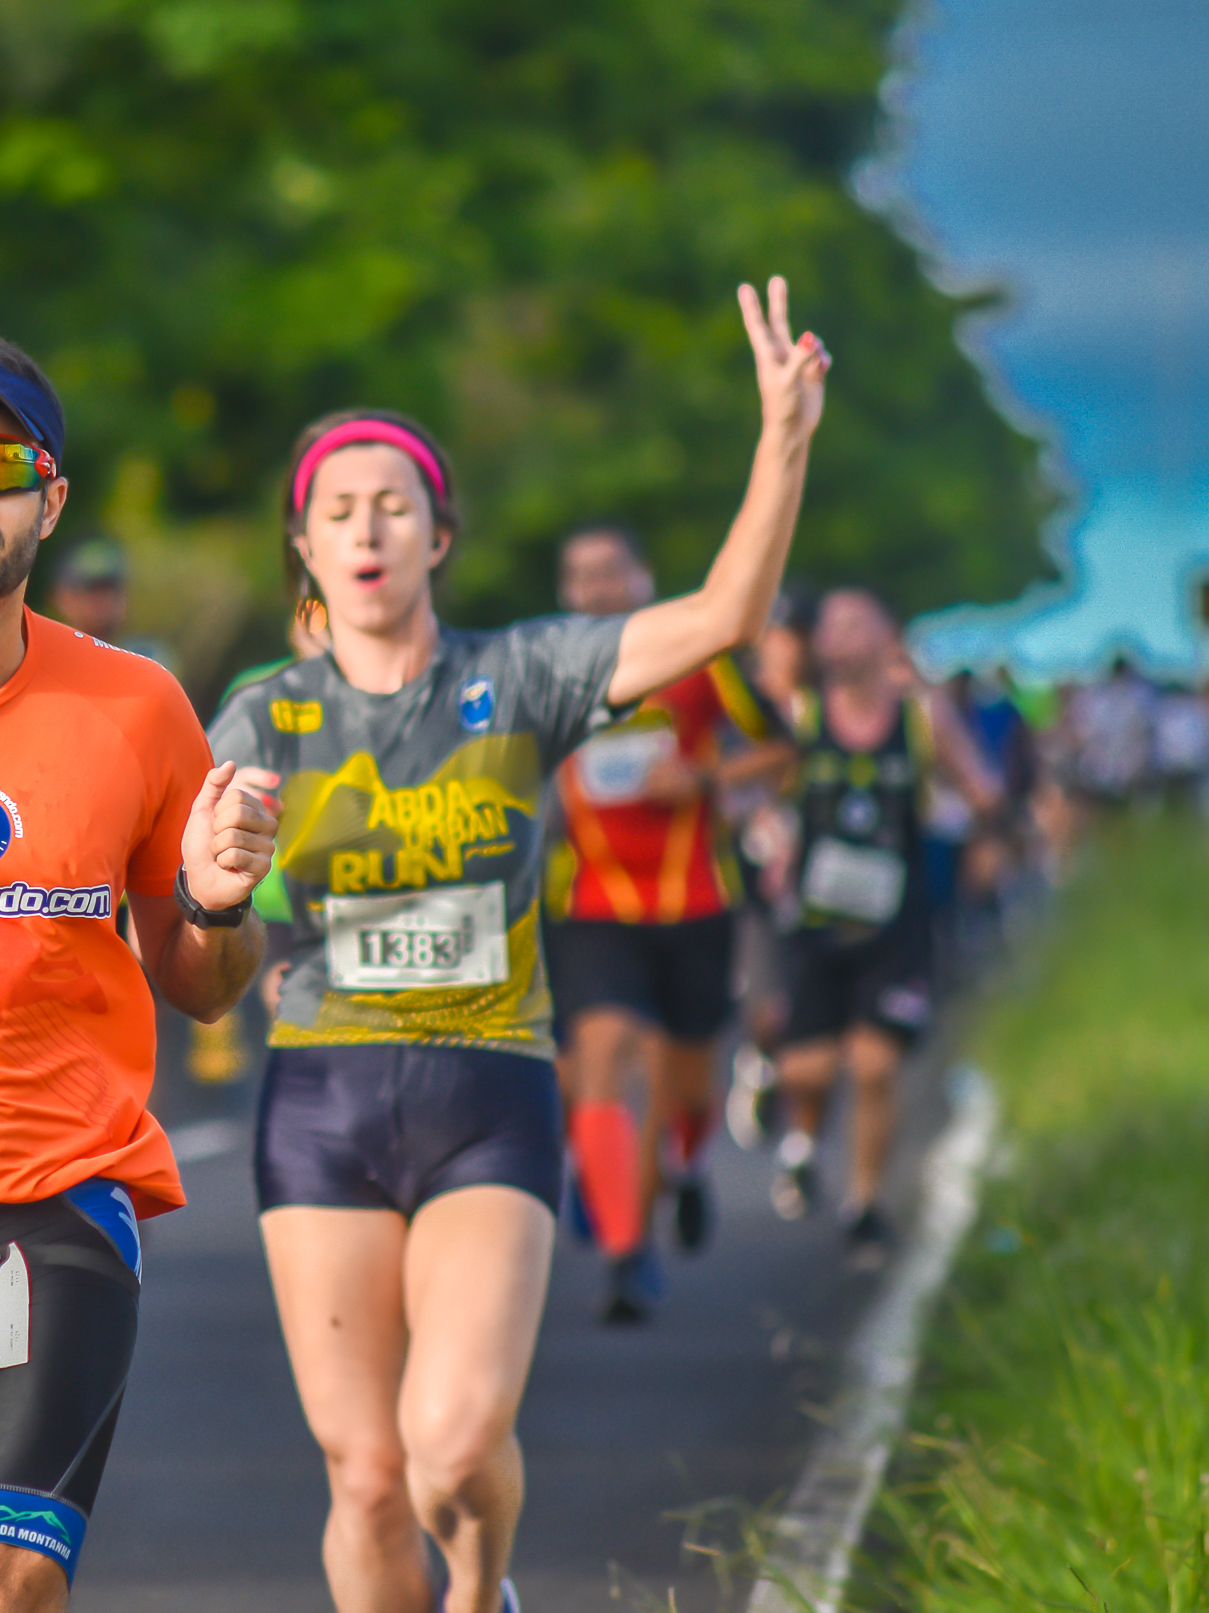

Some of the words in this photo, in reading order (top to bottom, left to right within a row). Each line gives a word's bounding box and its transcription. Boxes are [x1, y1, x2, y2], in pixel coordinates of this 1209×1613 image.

[368, 779, 476, 830] ABDA
[328, 845, 464, 894] RUN
[365, 932, 458, 967] 1383
[17, 1528, 72, 1561] MONTANHA
